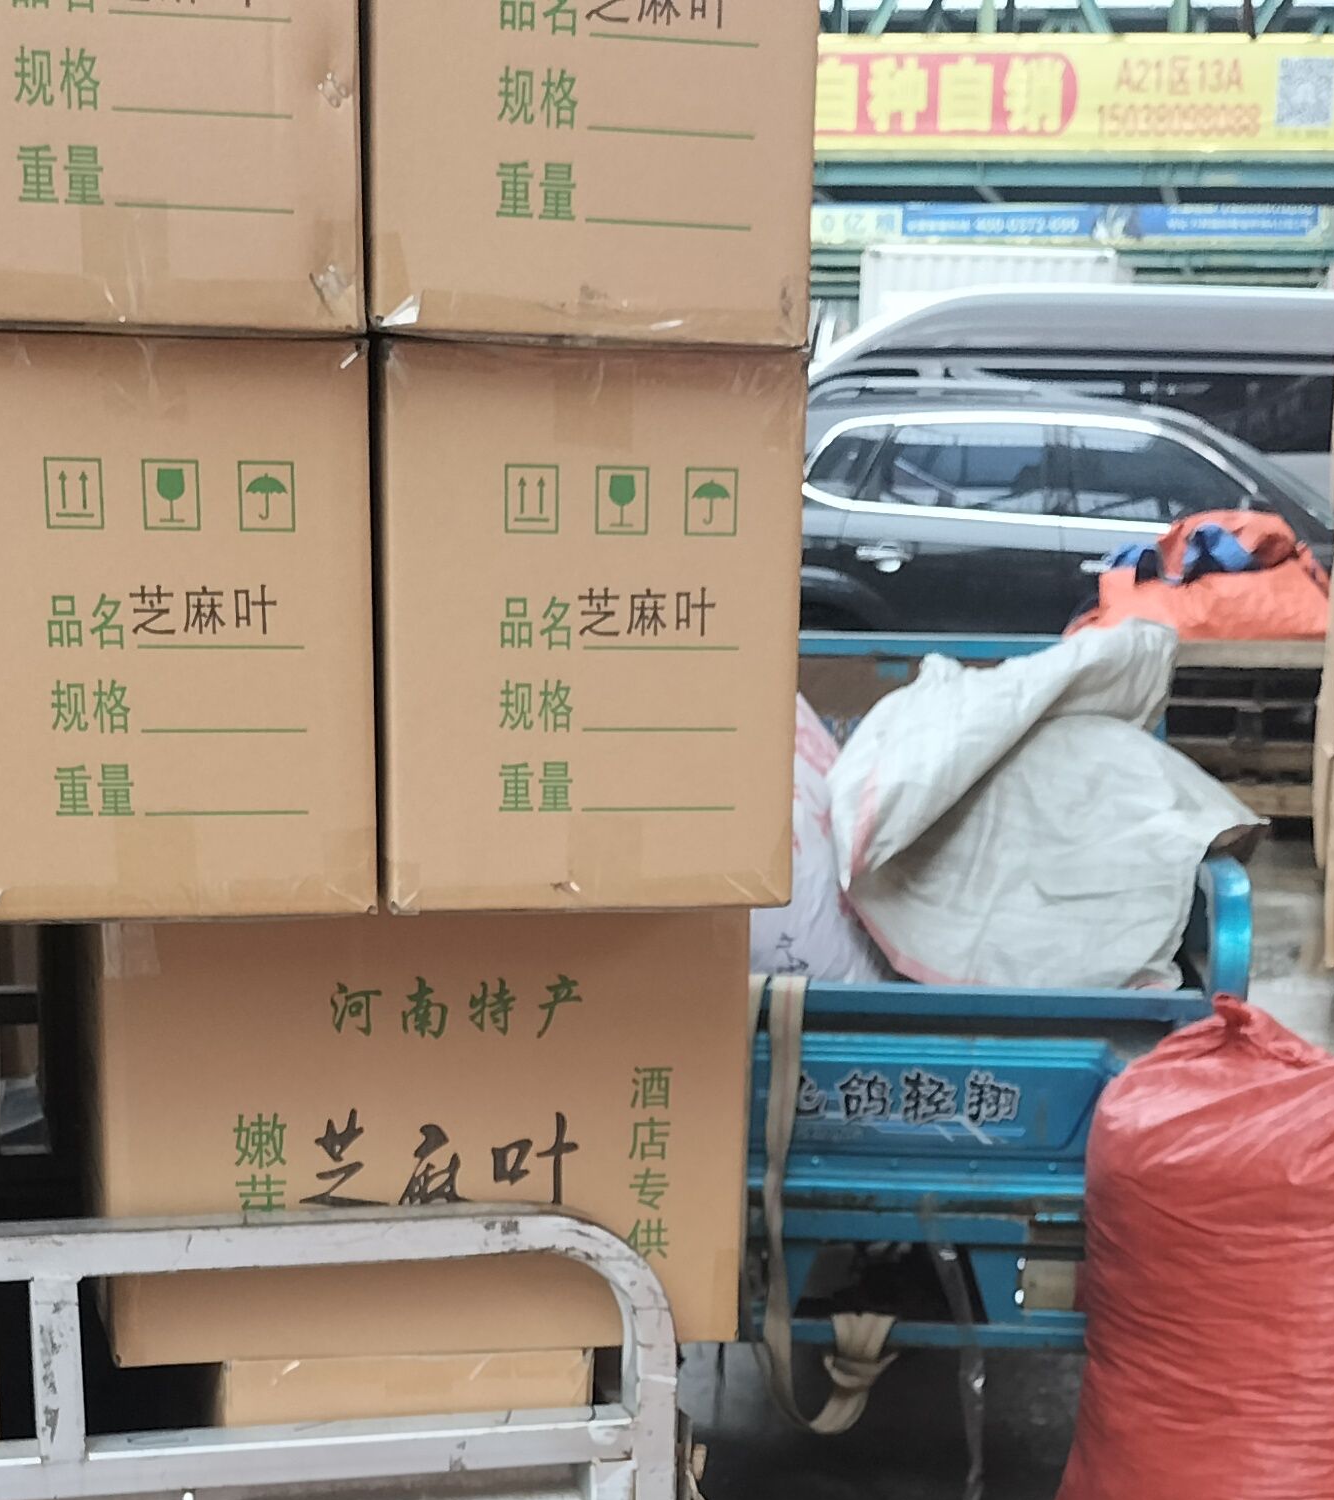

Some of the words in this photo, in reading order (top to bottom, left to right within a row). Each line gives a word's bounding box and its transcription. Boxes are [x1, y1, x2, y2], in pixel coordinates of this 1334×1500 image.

[13, 45, 104, 112] 规格
[496, 65, 579, 131] 规格
[16, 144, 105, 206] 重量
[495, 160, 577, 222] 重量
[47, 584, 278, 651] 品名芝麻叶
[499, 586, 717, 651] 品名芝麻叶
[50, 679, 132, 735] 规格
[498, 679, 574, 734] 规格
[54, 763, 136, 818] 重量
[498, 761, 574, 814] 重量
[329, 973, 584, 1039] 河南特产
[232, 1112, 288, 1213] 嫩芽
[298, 1106, 580, 1207] 芝麻叶
[628, 1065, 674, 1261] 酒店专供
